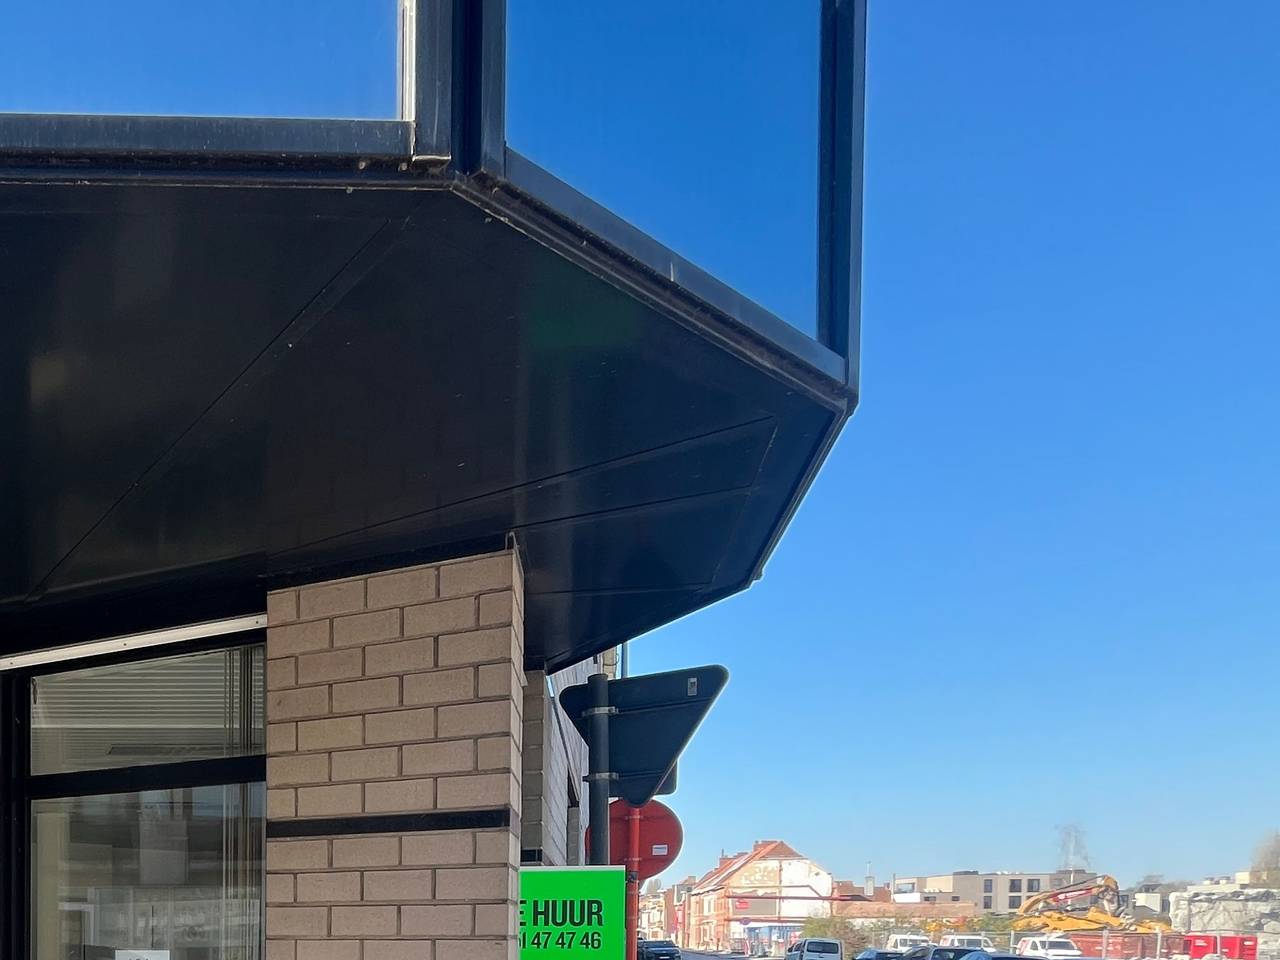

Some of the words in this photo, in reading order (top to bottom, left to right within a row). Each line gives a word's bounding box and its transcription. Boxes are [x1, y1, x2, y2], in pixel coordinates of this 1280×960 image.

[532, 899, 603, 927] HUUR
[531, 932, 552, 949] 47
[555, 932, 576, 949] 47
[579, 931, 601, 949] 46
